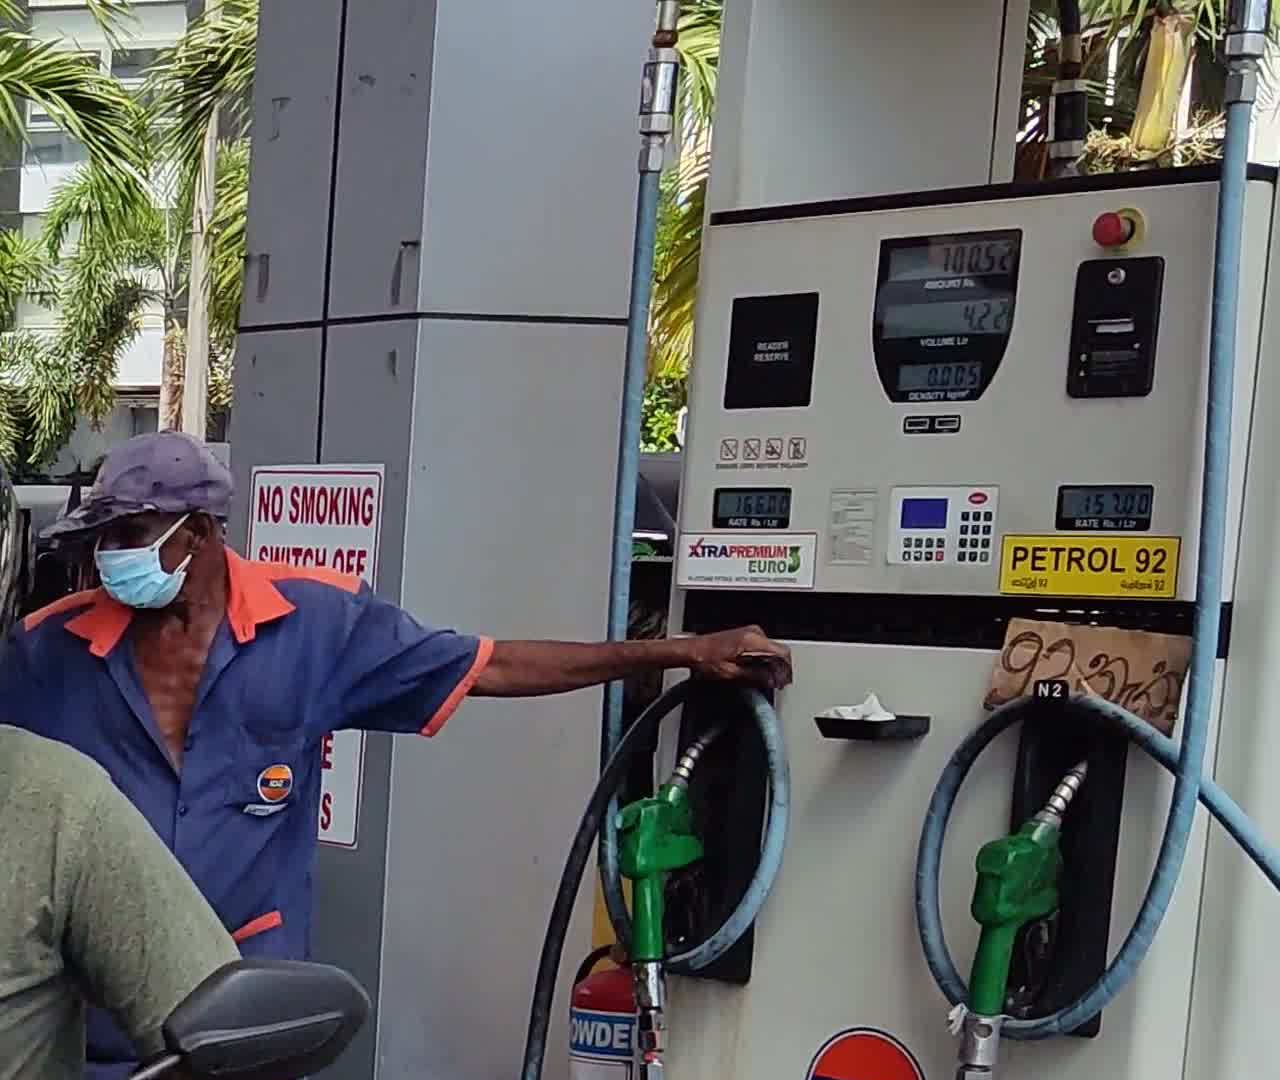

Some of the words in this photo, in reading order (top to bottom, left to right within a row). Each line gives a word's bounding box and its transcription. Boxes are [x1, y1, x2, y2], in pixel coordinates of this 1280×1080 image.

[920, 338, 955, 347] VOLUME
[257, 485, 284, 523] NO
[289, 485, 374, 526] SMOKING
[1075, 519, 1099, 528] RATE
[688, 537, 788, 558] XTRAPREMIUM
[748, 560, 787, 573] EURO
[1012, 546, 1125, 572] PETROL
[1136, 548, 1167, 573] 92
